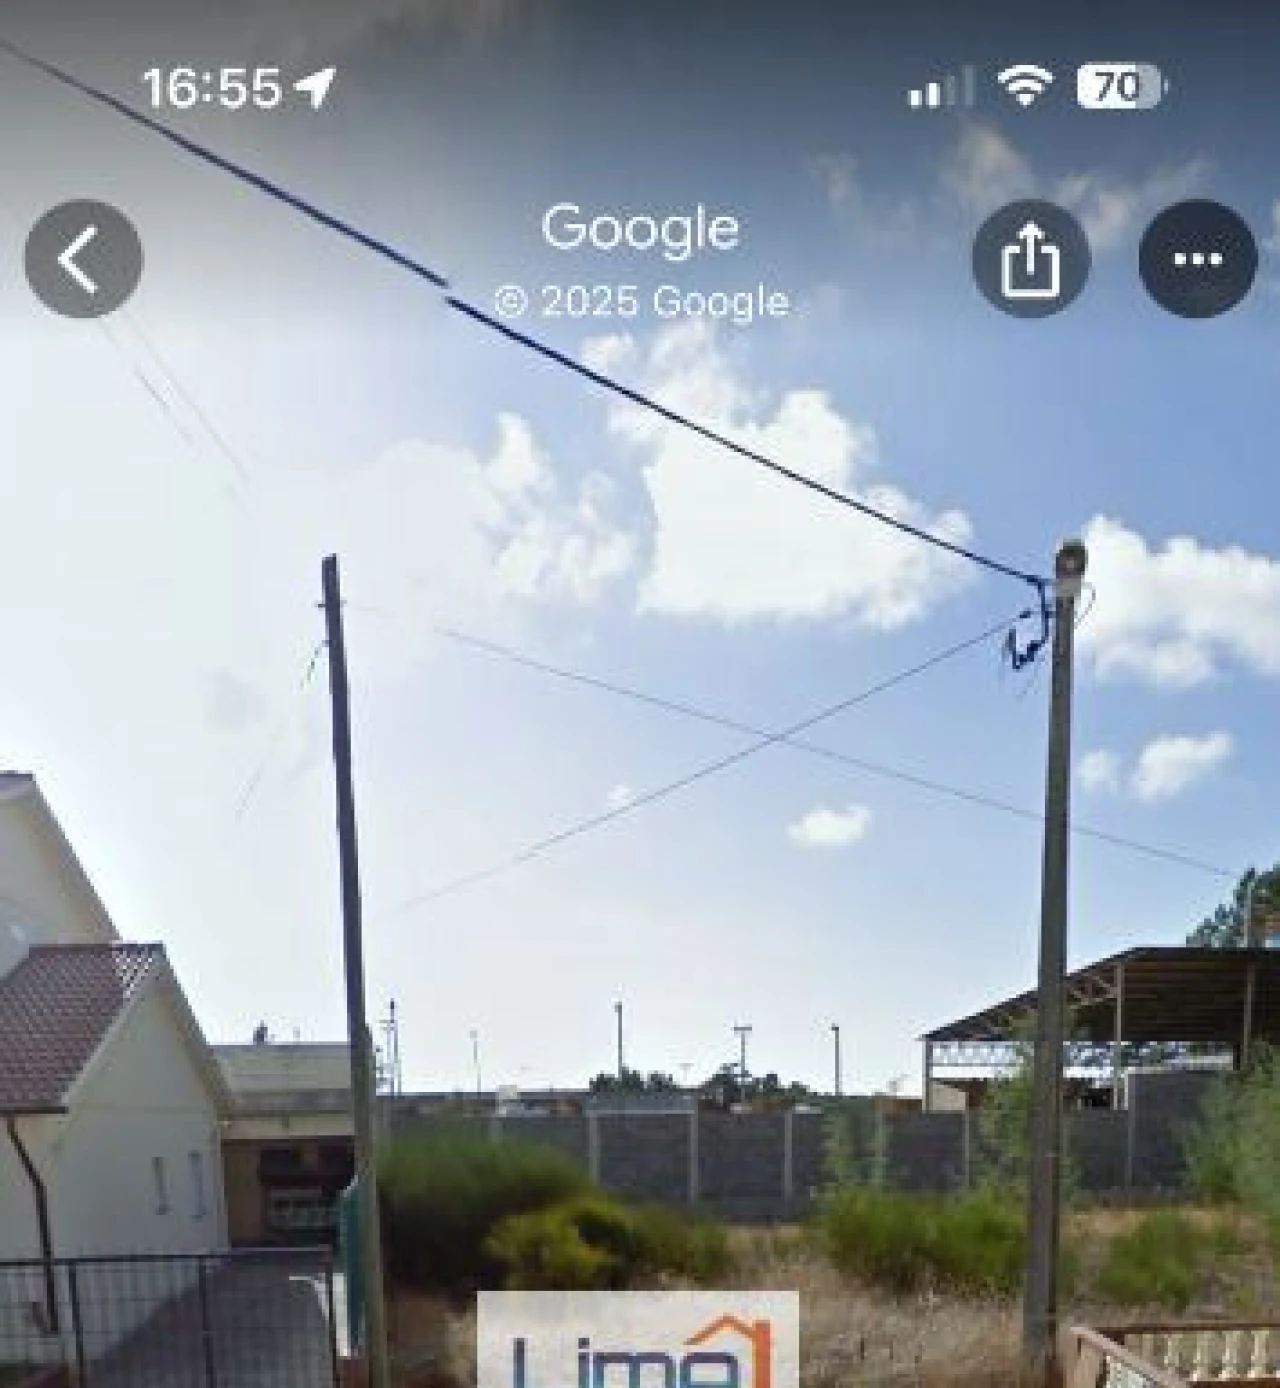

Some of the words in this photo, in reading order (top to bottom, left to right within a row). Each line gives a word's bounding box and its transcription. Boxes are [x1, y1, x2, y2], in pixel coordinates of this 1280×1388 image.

[143, 68, 283, 110] 16:55
[1095, 72, 1140, 102] 70
[541, 202, 740, 262] Google
[541, 284, 638, 319] 2025
[653, 283, 790, 323] Google
